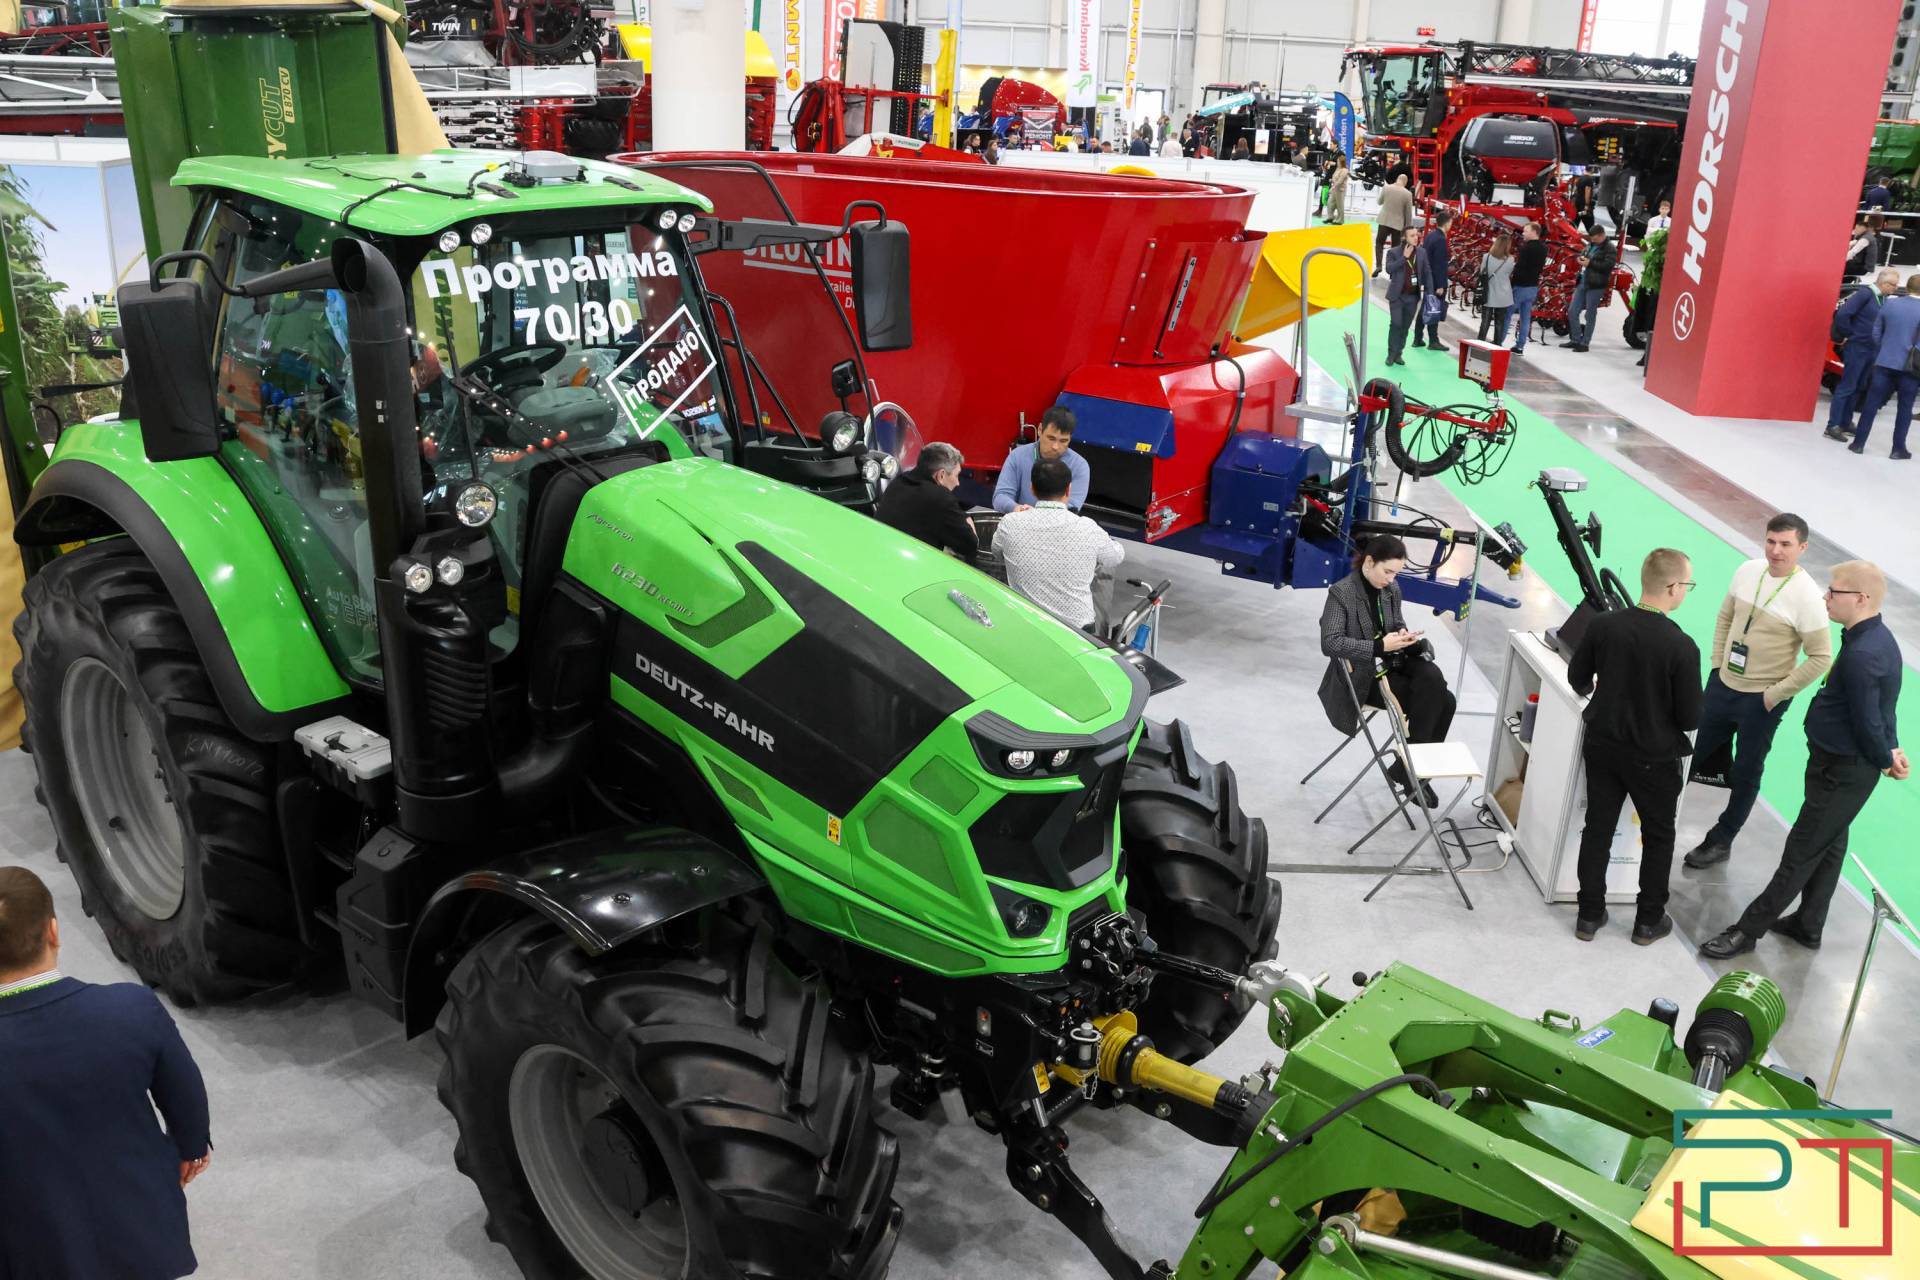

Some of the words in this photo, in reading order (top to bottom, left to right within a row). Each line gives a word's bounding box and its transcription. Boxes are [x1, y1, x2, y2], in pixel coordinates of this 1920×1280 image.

[432, 22, 461, 31] TWIN
[1682, 0, 1748, 285] HORSCH
[420, 250, 679, 303] Программа
[513, 298, 633, 346] 70/30
[623, 330, 700, 411] ПРОДАНО
[635, 652, 775, 753] DEUTZ-FAHR
